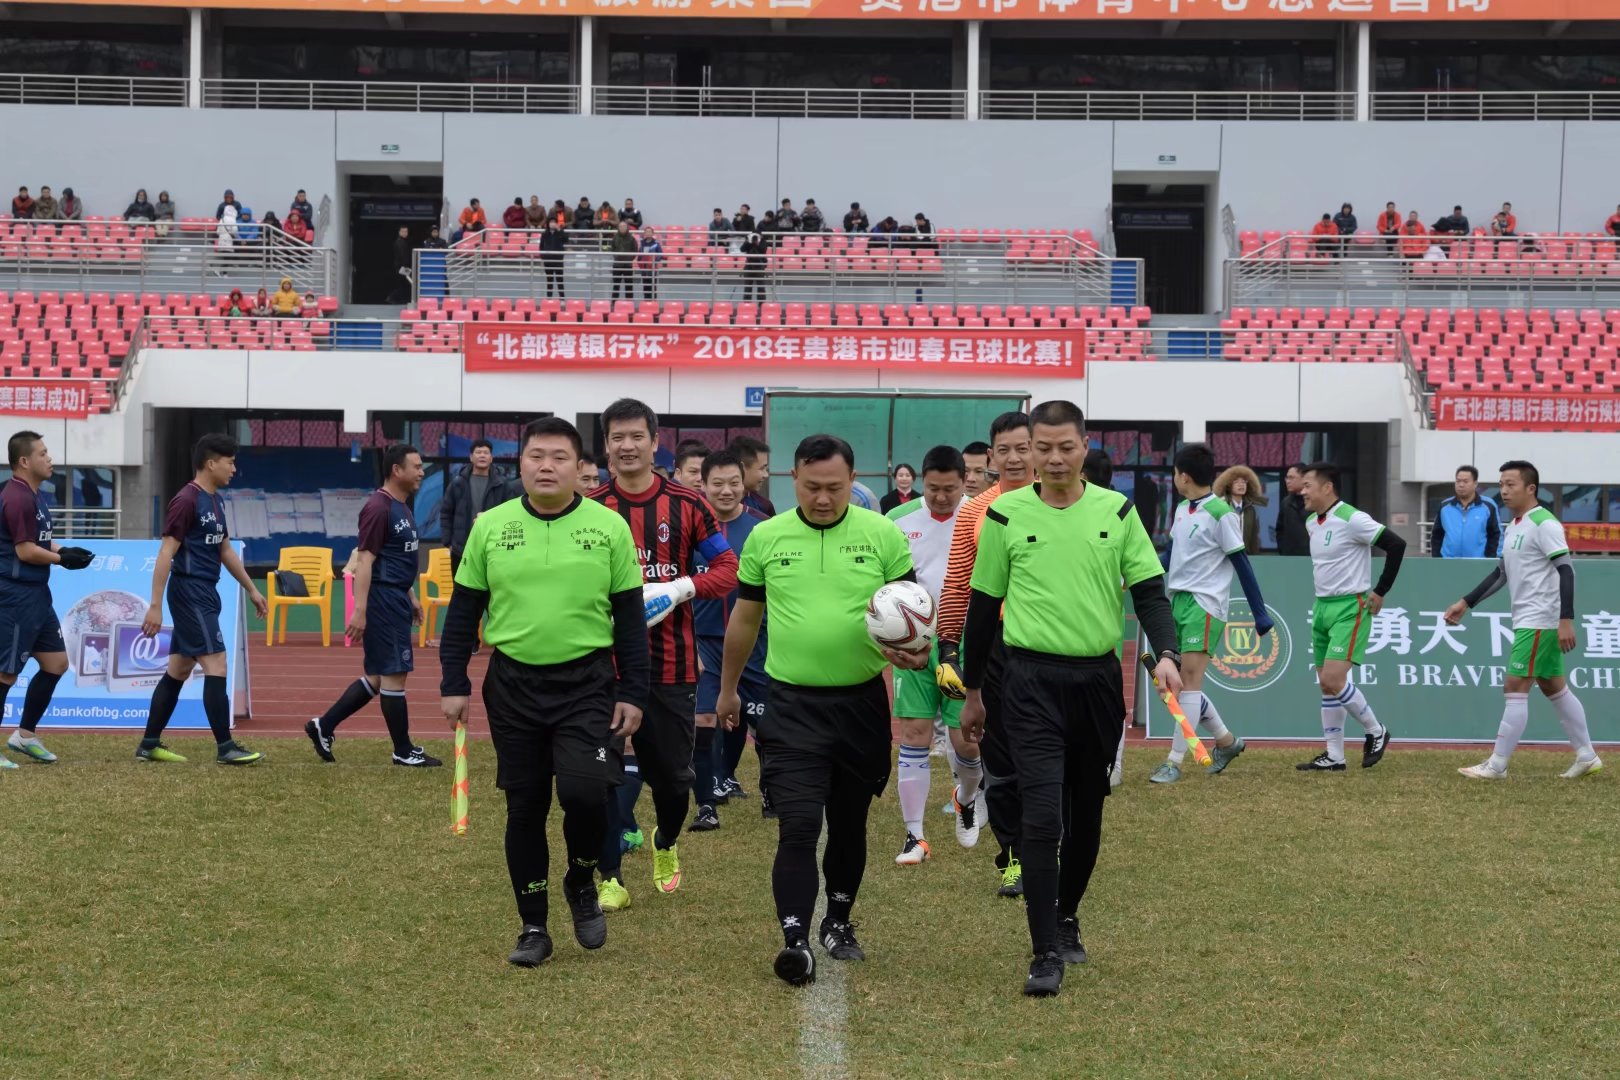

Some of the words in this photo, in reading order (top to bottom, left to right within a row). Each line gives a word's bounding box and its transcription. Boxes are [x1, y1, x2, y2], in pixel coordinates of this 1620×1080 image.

[1188, 524, 1200, 539] 7
[1324, 530, 1333, 546] 9
[638, 547, 651, 561] ly
[641, 562, 678, 578] rates
[1306, 606, 1515, 657] 勇天下
[1581, 610, 1620, 658] 童
[1397, 663, 1507, 687] BRAVE
[1569, 666, 1620, 689] CH
[17, 702, 150, 719] w.bankofbbg.com
[747, 702, 765, 716] 26
